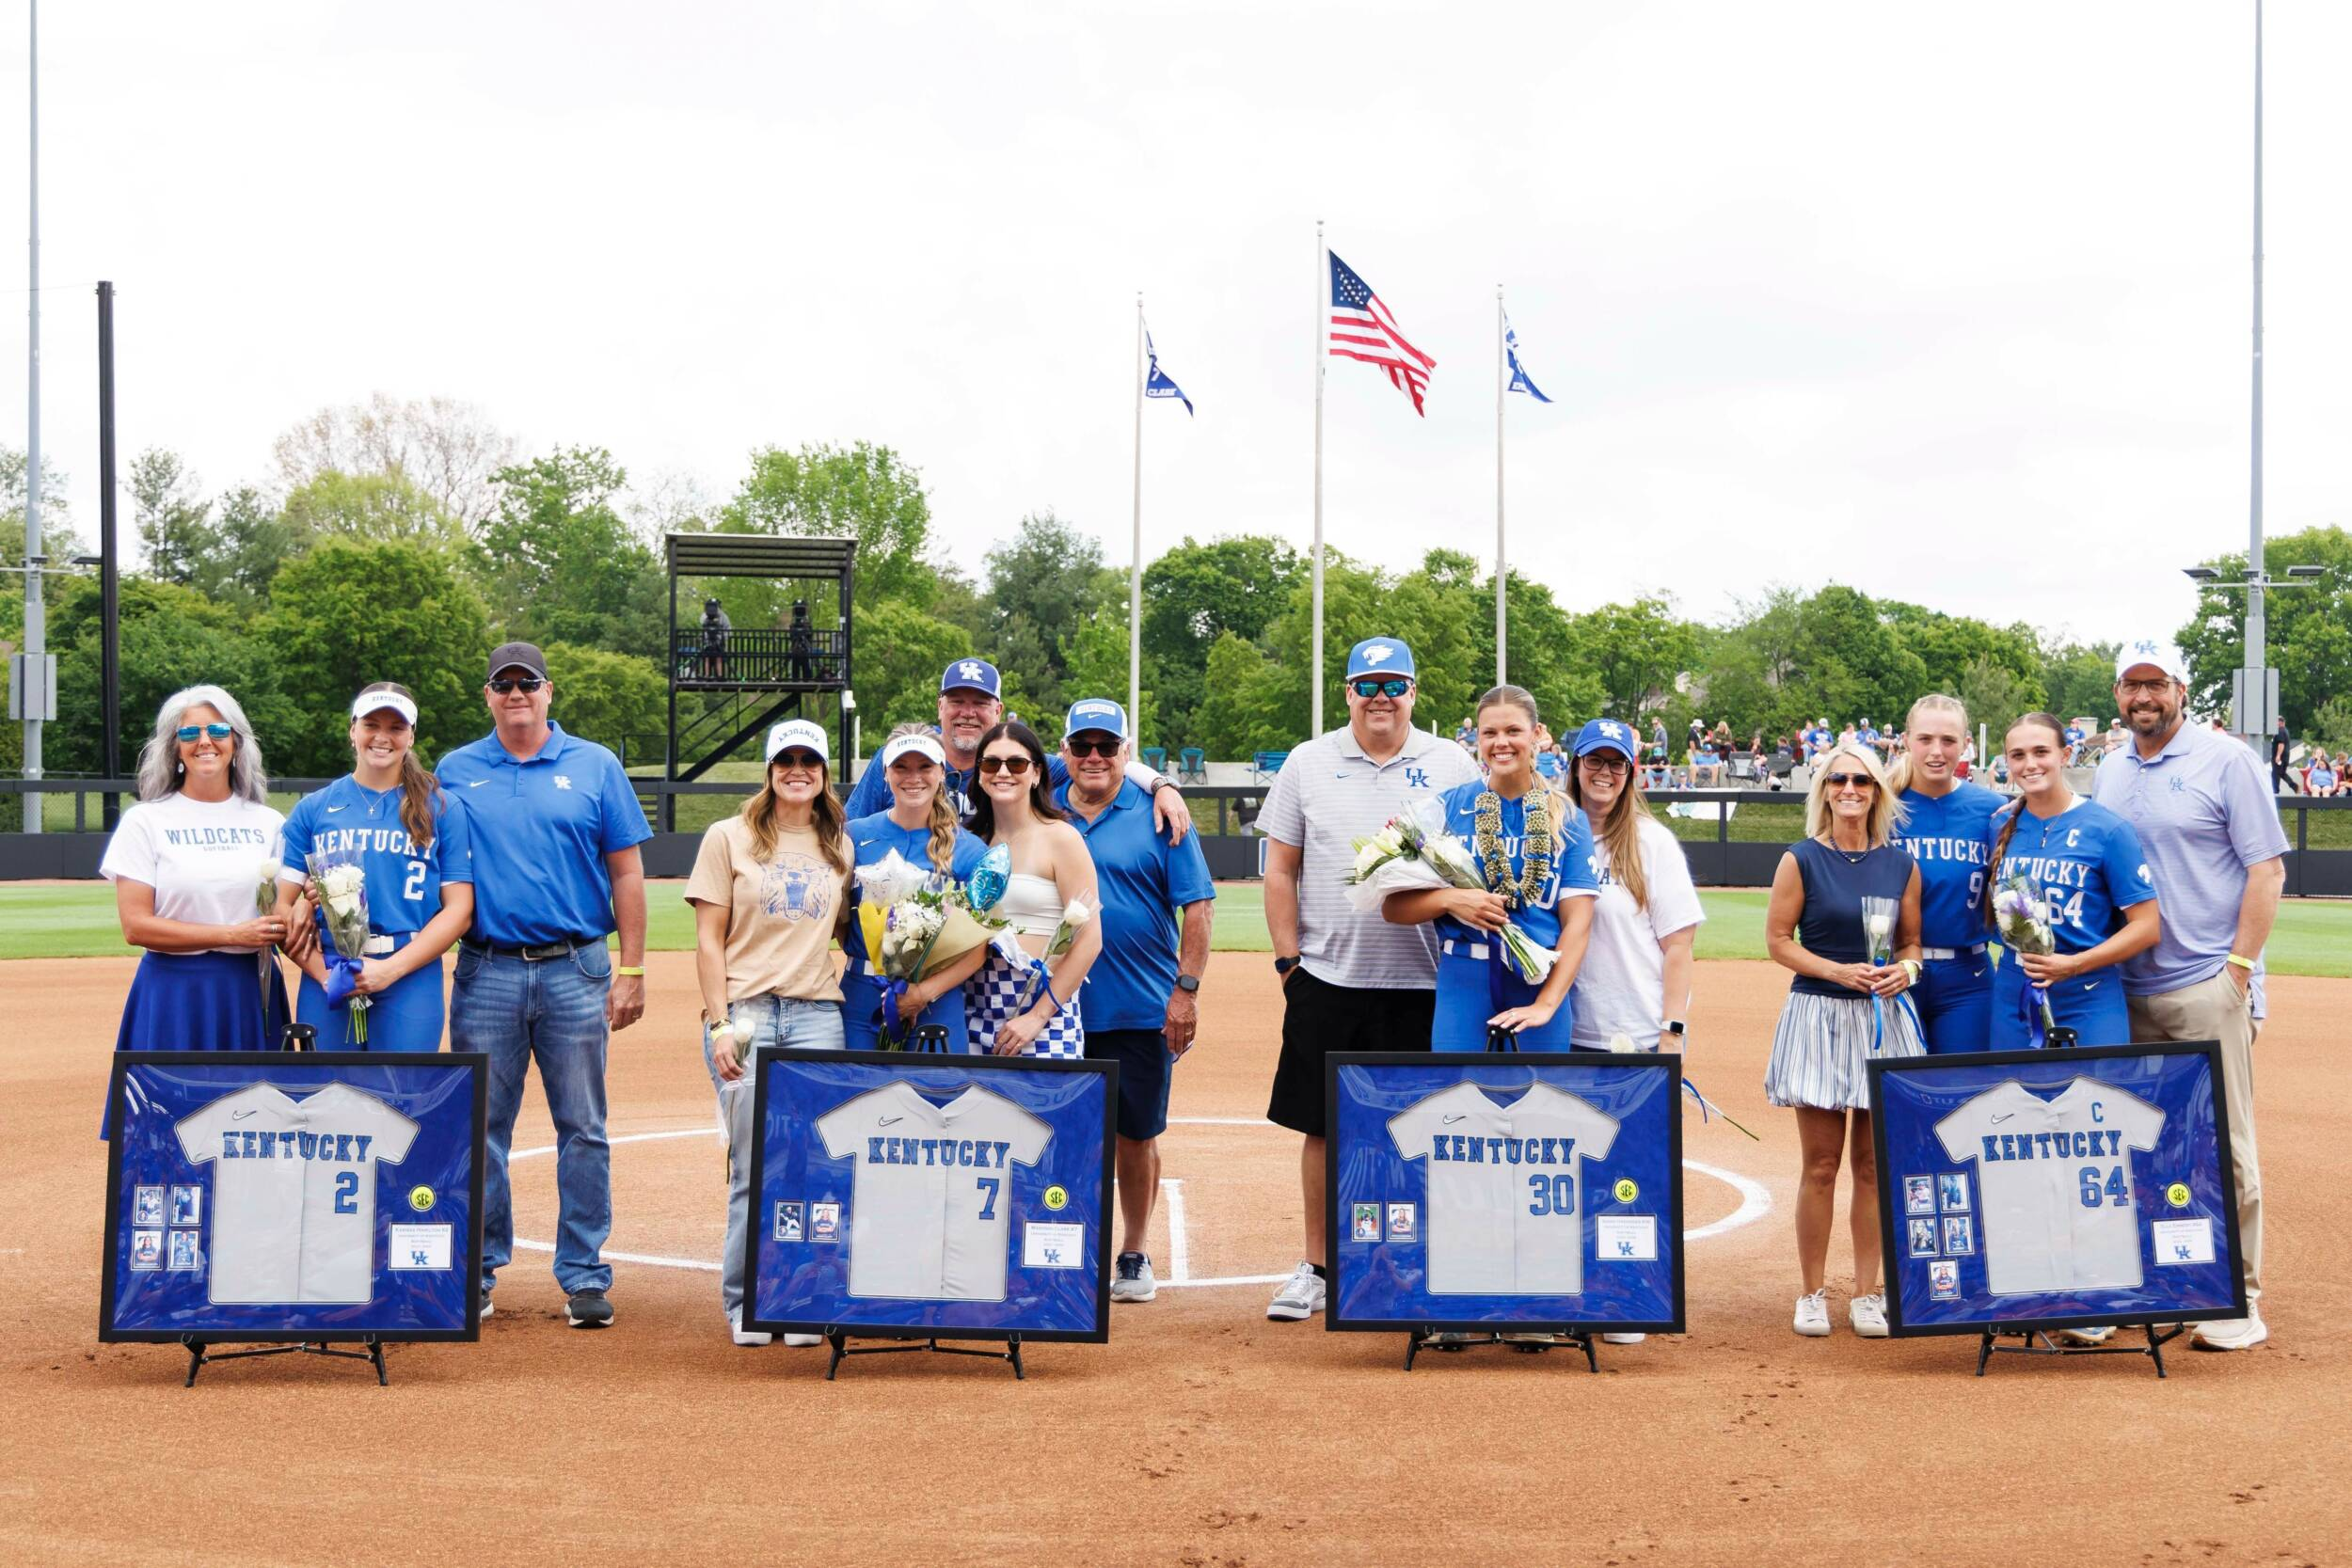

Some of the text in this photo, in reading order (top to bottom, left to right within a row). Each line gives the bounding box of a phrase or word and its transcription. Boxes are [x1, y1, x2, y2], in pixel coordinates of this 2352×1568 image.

[1405, 768, 1430, 788] UK
[165, 828, 265, 845] WILDCATS
[2066, 829, 2080, 847] C
[404, 861, 426, 900] 2
[1966, 871, 1984, 910] 9
[2043, 887, 2086, 927] 64
[2090, 1101, 2104, 1123] C
[222, 1131, 373, 1163] KENTUCKY
[867, 1136, 1010, 1169] KENTUCKY
[1433, 1134, 1575, 1165] KENTUCKY
[1981, 1129, 2122, 1163] KENTUCKY
[334, 1171, 358, 1214] 2
[1050, 1191, 1063, 1204] SEC
[1528, 1174, 1575, 1216] 30
[1620, 1183, 1632, 1197] SEC
[2078, 1165, 2129, 1208] 64
[2173, 1188, 2185, 1201] SEC
[416, 1193, 430, 1206] SEC
[977, 1177, 1000, 1220] 7
[411, 1250, 429, 1265] UK
[1043, 1248, 1061, 1263] UK
[1617, 1241, 1634, 1256] UK
[2174, 1245, 2192, 1260] UK
